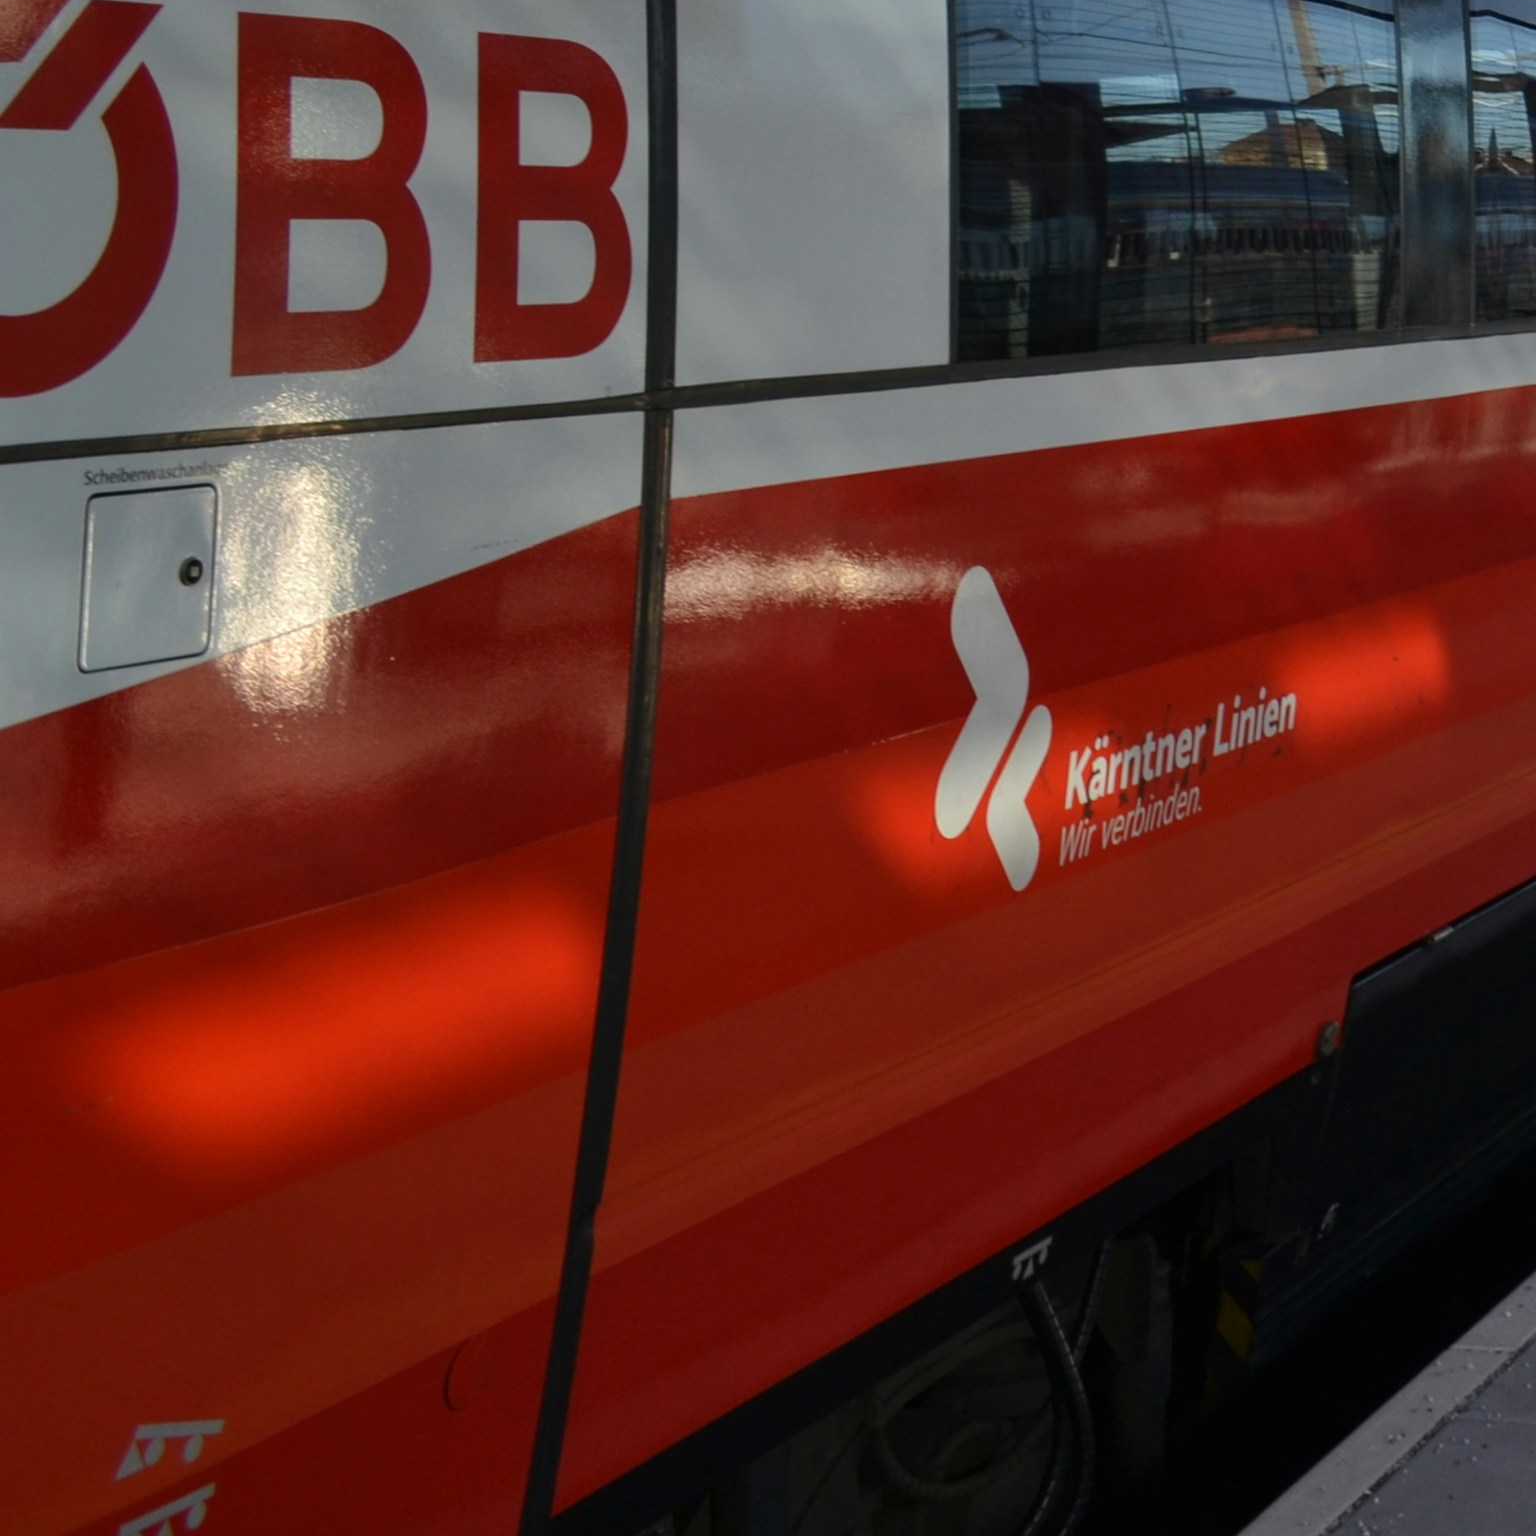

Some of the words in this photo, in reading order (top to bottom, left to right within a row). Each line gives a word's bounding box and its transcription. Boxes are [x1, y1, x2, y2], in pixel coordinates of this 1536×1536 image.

[1064, 724, 1207, 810] Kärntner
[1212, 686, 1297, 757] Linien
[1059, 818, 1097, 867] Wir
[1101, 783, 1203, 850] verbinden.
